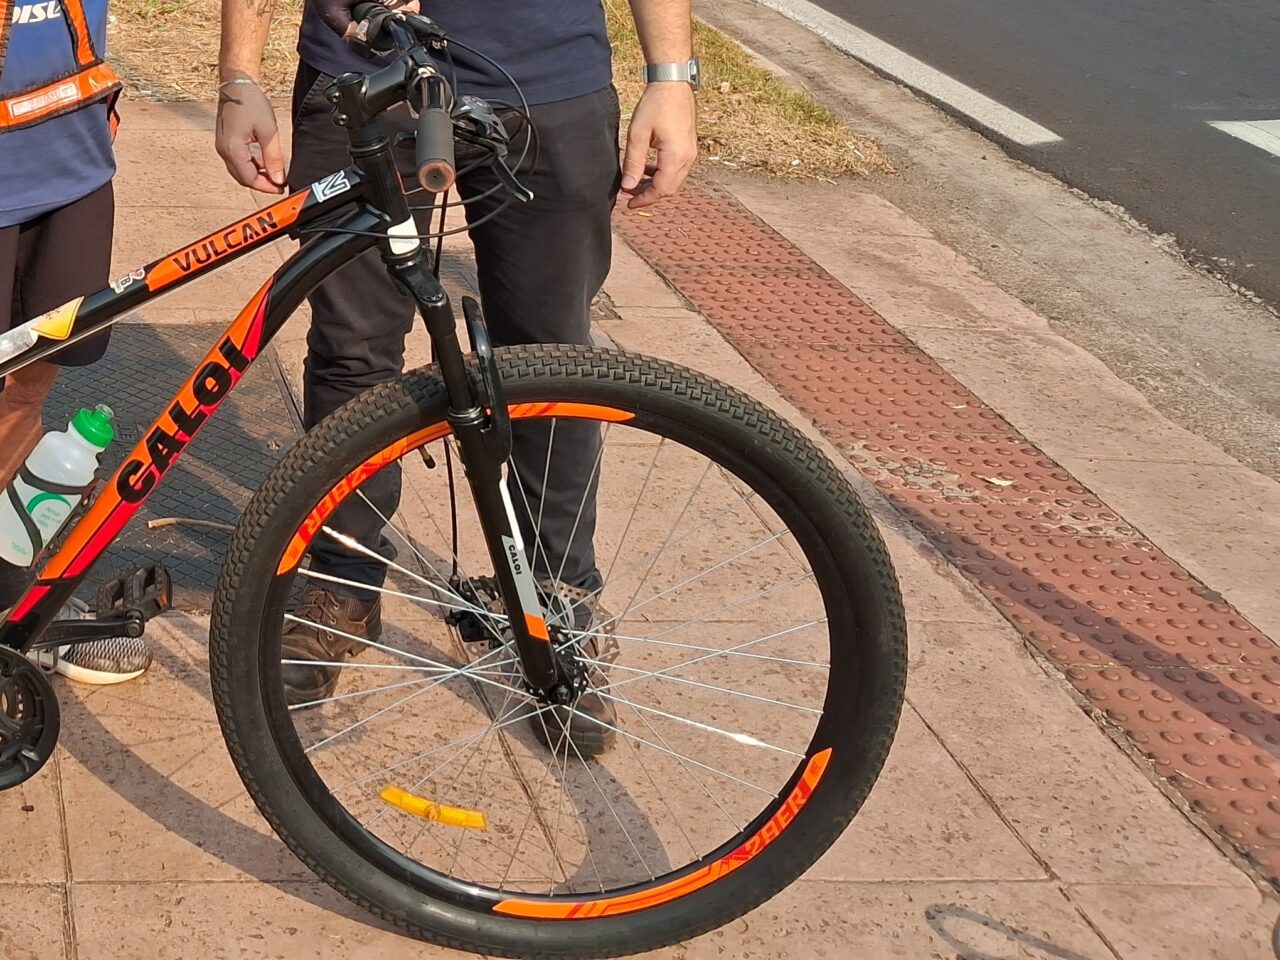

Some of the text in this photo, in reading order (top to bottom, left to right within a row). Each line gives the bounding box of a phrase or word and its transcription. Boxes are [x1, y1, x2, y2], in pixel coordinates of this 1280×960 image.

[173, 211, 278, 273] VULCAN
[117, 335, 251, 504] CALOI
[508, 544, 522, 575] CALOI
